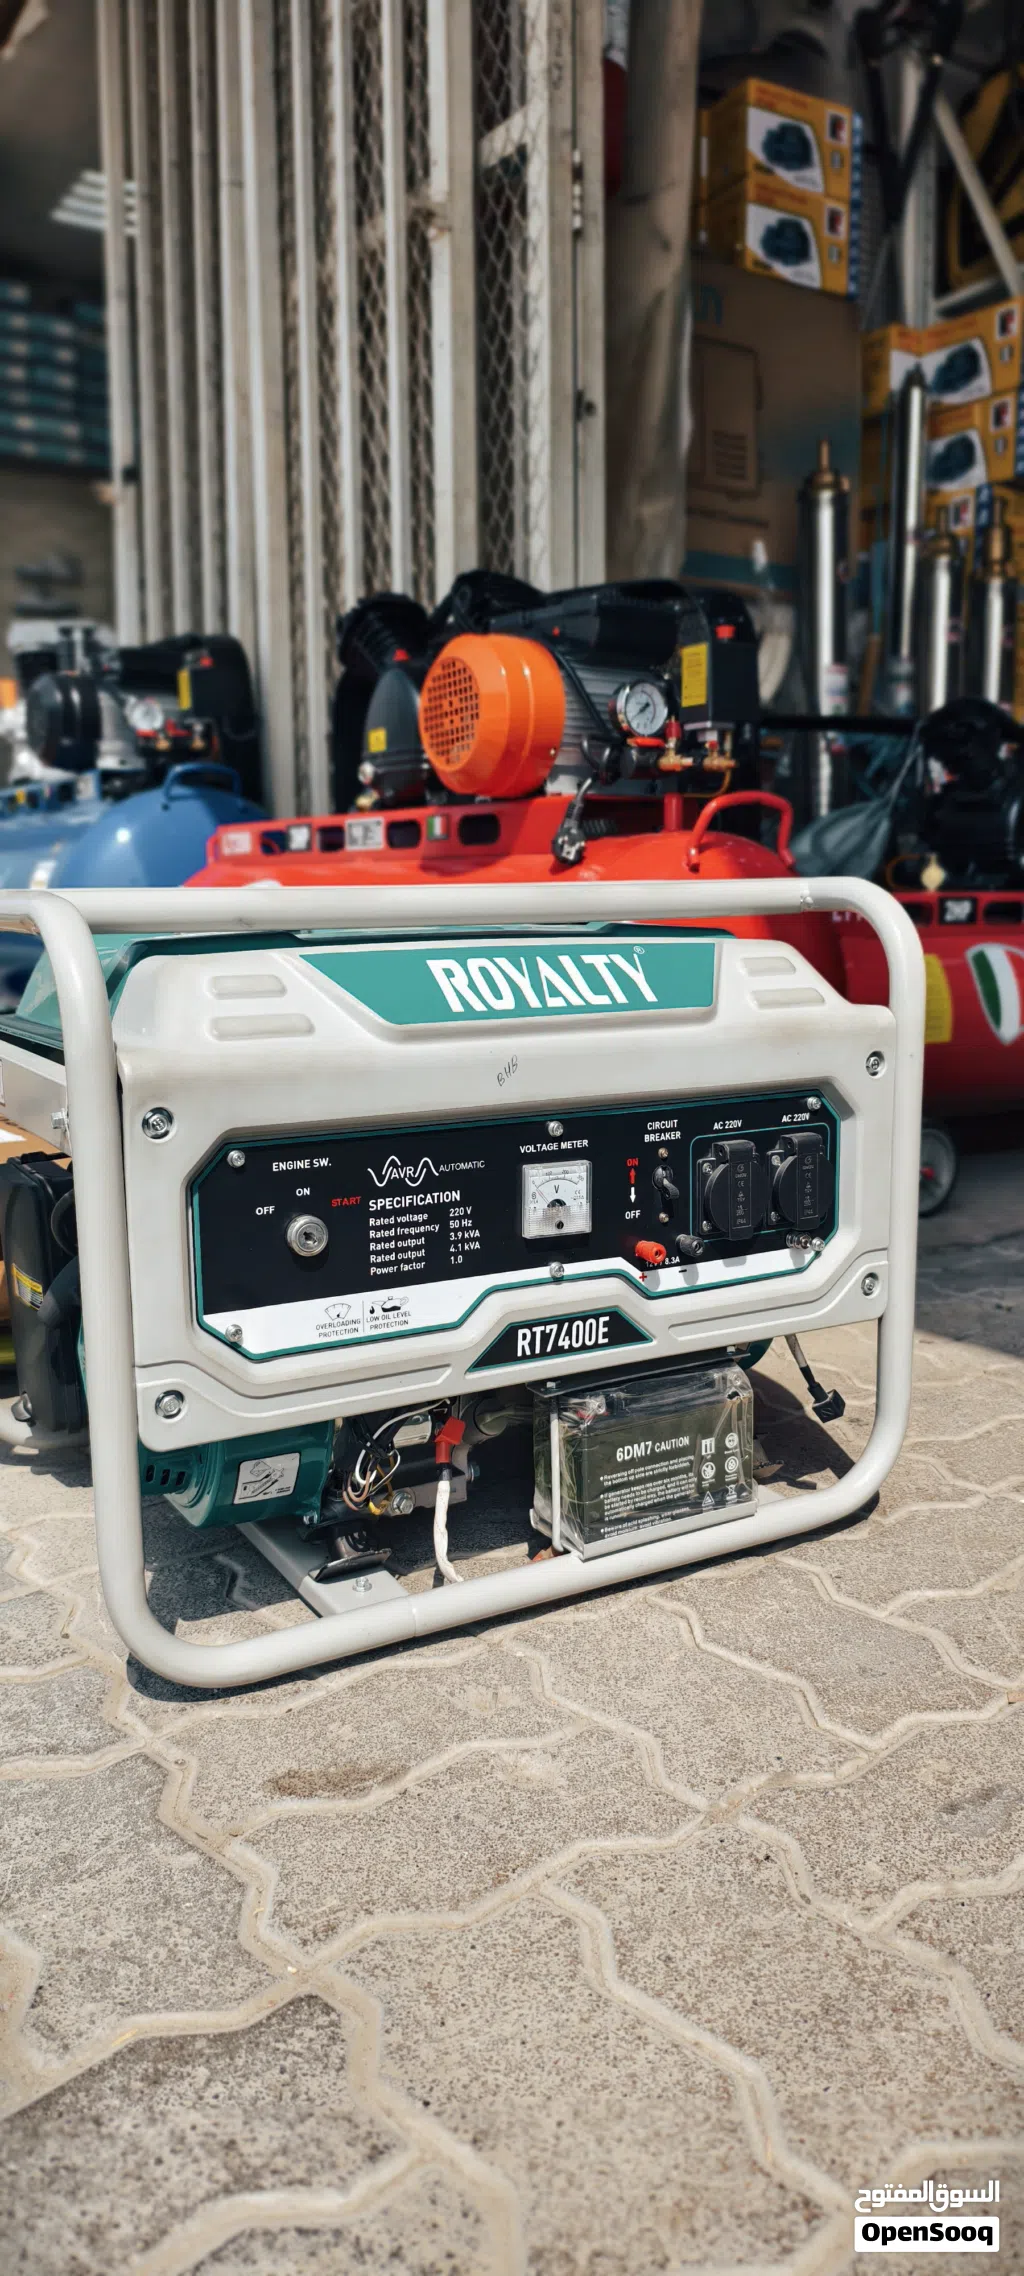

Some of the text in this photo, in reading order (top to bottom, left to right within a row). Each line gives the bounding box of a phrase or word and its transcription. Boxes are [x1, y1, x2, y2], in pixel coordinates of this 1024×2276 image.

[425, 953, 659, 1013] ROYALTY
[781, 1112, 810, 1123] AC 220V
[647, 1119, 679, 1131] CIRCUIT
[713, 1119, 742, 1130] AC 220V
[644, 1131, 682, 1143] BREAKER
[519, 1139, 589, 1153] VOLTAGE METER
[272, 1157, 332, 1172] ENGINE SW.
[626, 1157, 639, 1167] ON
[390, 1160, 486, 1180] AVR AUTOMATIC
[295, 1187, 311, 1196] ON
[554, 1184, 560, 1194] V
[331, 1196, 361, 1207] START
[368, 1189, 461, 1211] SPECIFICATION
[255, 1205, 276, 1216] OFF
[369, 1206, 472, 1227] Rated voltage 220 V
[625, 1210, 641, 1220] OFF
[369, 1218, 473, 1239] Rated frequency 50 Hz
[369, 1229, 481, 1251] Rated output 3.9 kVA
[370, 1241, 481, 1263] Rated output 4.1 kVA
[370, 1255, 463, 1276] Power factor 1.0
[381, 1313, 391, 1321] OIL
[392, 1311, 412, 1319] LEVEL
[315, 1318, 361, 1331] OVERLOADING
[369, 1319, 409, 1330] PROTECTION
[318, 1327, 359, 1338] PROTECTION
[516, 1315, 610, 1357] RT7400E
[616, 1435, 690, 1462] 6DM7 CAUTION
